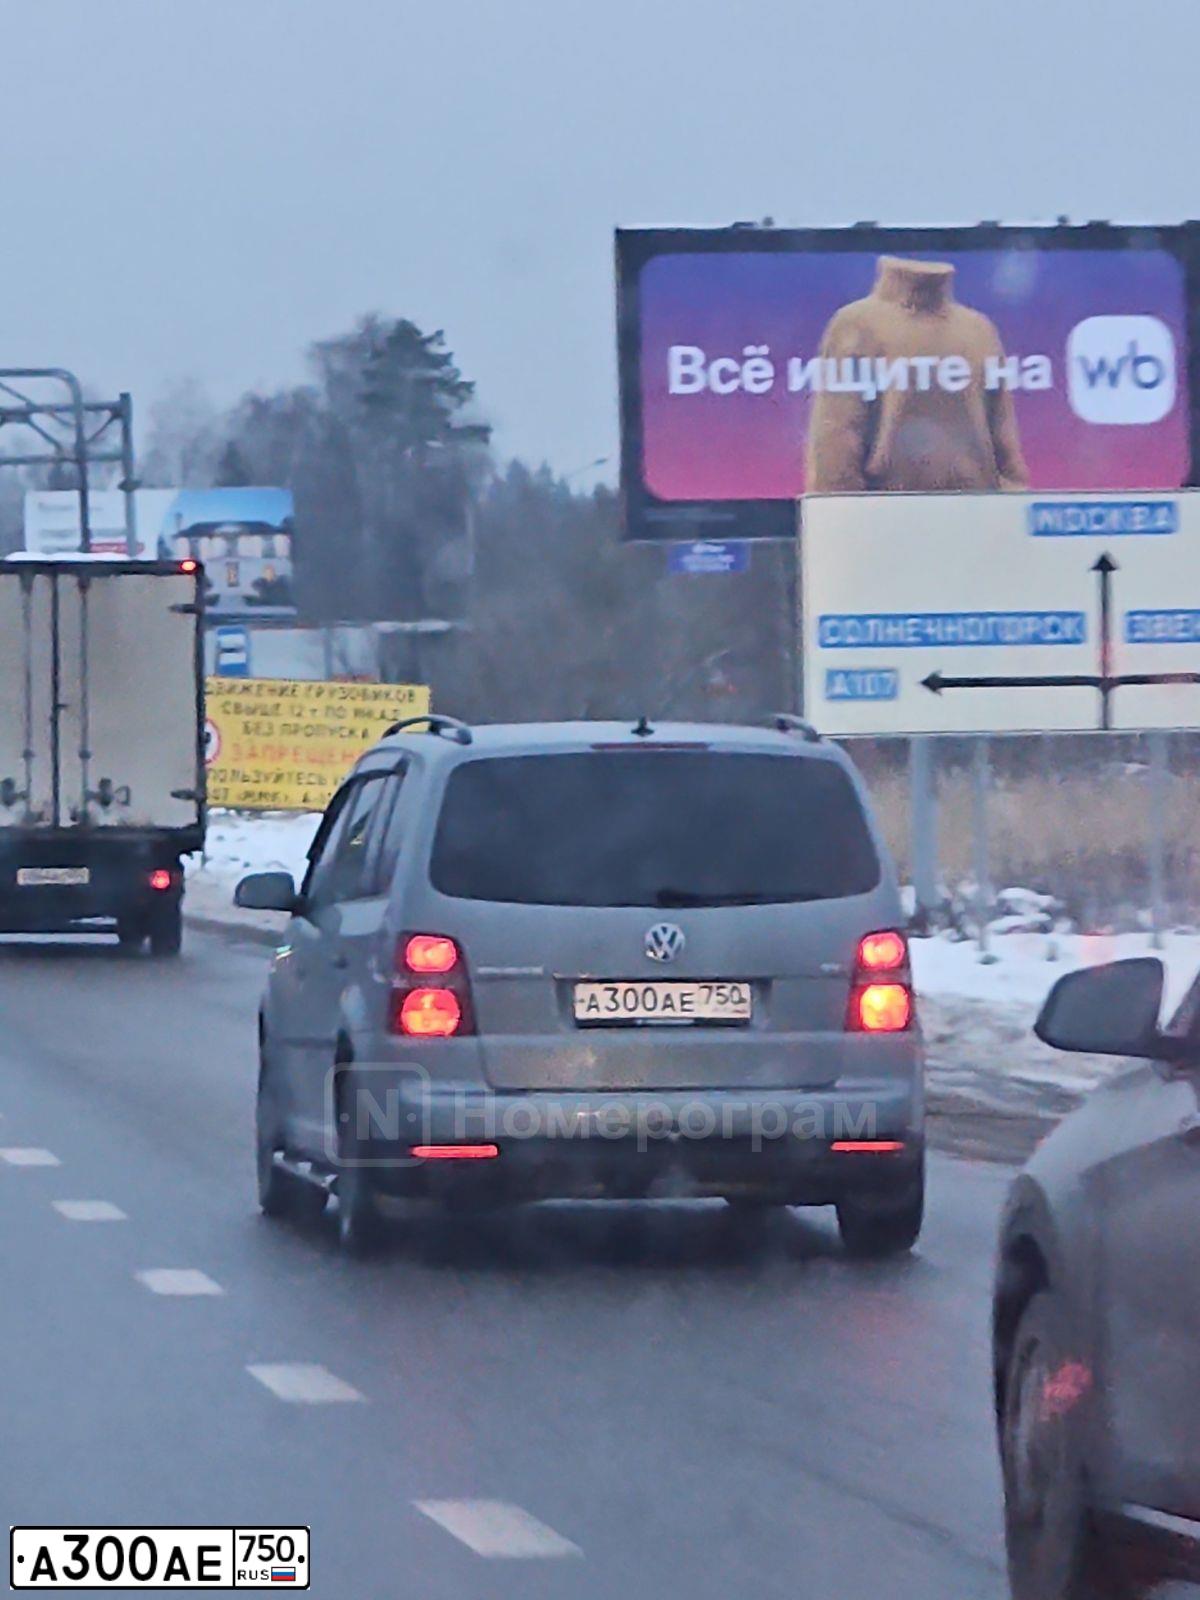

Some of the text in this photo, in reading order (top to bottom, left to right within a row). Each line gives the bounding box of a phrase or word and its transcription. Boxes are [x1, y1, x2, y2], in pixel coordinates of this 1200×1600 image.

[667, 344, 1053, 402] Всё ищите на
[1036, 505, 1171, 531] МОСКВА
[821, 615, 1083, 644] СОЛНЕЧНОГОРСК
[231, 743, 360, 766] ЗАПРЕЩЕН
